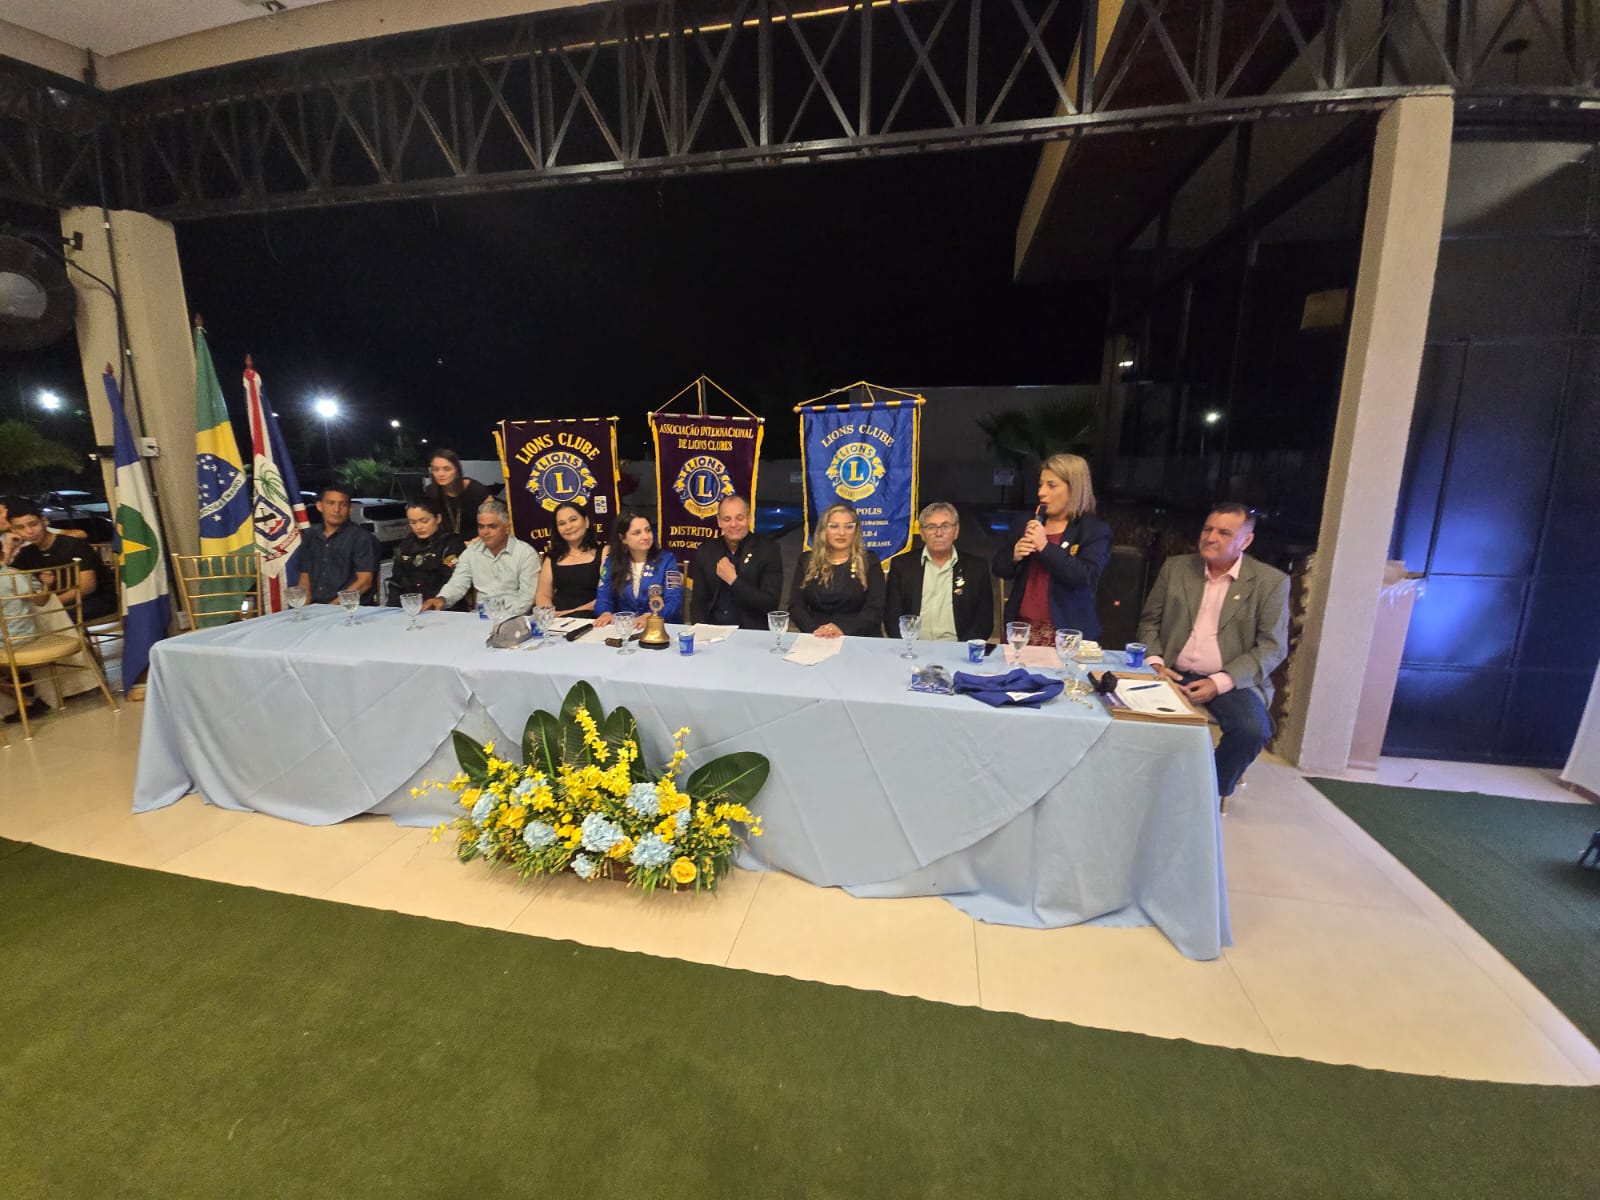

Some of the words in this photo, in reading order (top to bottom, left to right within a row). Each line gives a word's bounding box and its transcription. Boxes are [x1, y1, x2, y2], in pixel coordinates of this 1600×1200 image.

[659, 423, 699, 438] ASSOCIAÇÃO
[700, 425, 754, 439] INTERNACIONAL
[821, 424, 854, 448] LIONS
[858, 424, 895, 448] CLUBE
[515, 433, 554, 465] LIONS
[558, 432, 601, 461] CLUBE
[678, 438, 688, 449] DE
[688, 439, 707, 450] LIONS
[707, 440, 733, 451] CLUBES
[840, 444, 873, 459] LIONS
[541, 453, 578, 469] LIONS
[687, 457, 722, 473] LIONS
[849, 461, 864, 482] L
[554, 472, 574, 493] L
[698, 475, 713, 497] L
[856, 507, 882, 515] POLIS
[670, 525, 712, 538] DISTRITO
